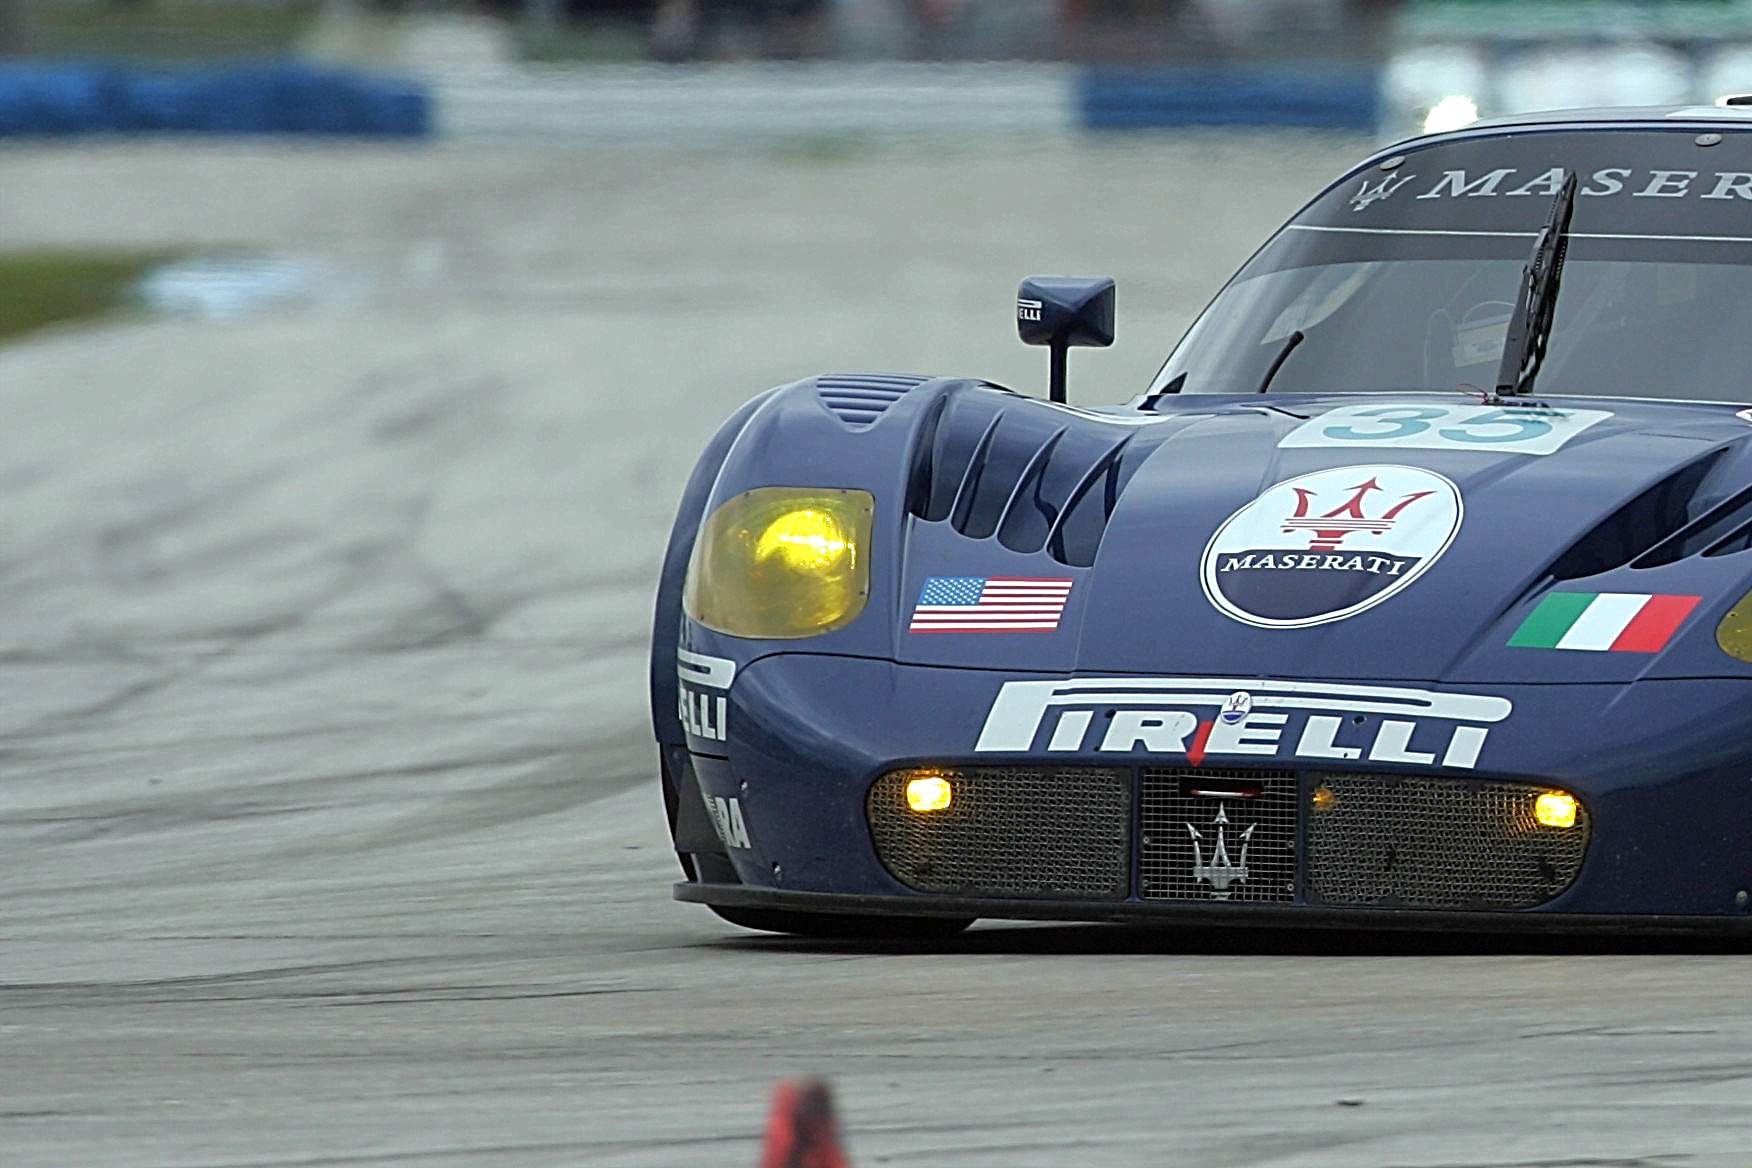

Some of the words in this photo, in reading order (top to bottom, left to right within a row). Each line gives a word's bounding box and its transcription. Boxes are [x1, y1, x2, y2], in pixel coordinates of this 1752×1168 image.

[1018, 299, 1042, 321] ELLI
[1323, 407, 1571, 443] 35
[1220, 553, 1405, 576] MASERATI
[678, 648, 737, 741] ELLI
[974, 678, 1513, 769] PIRELLI
